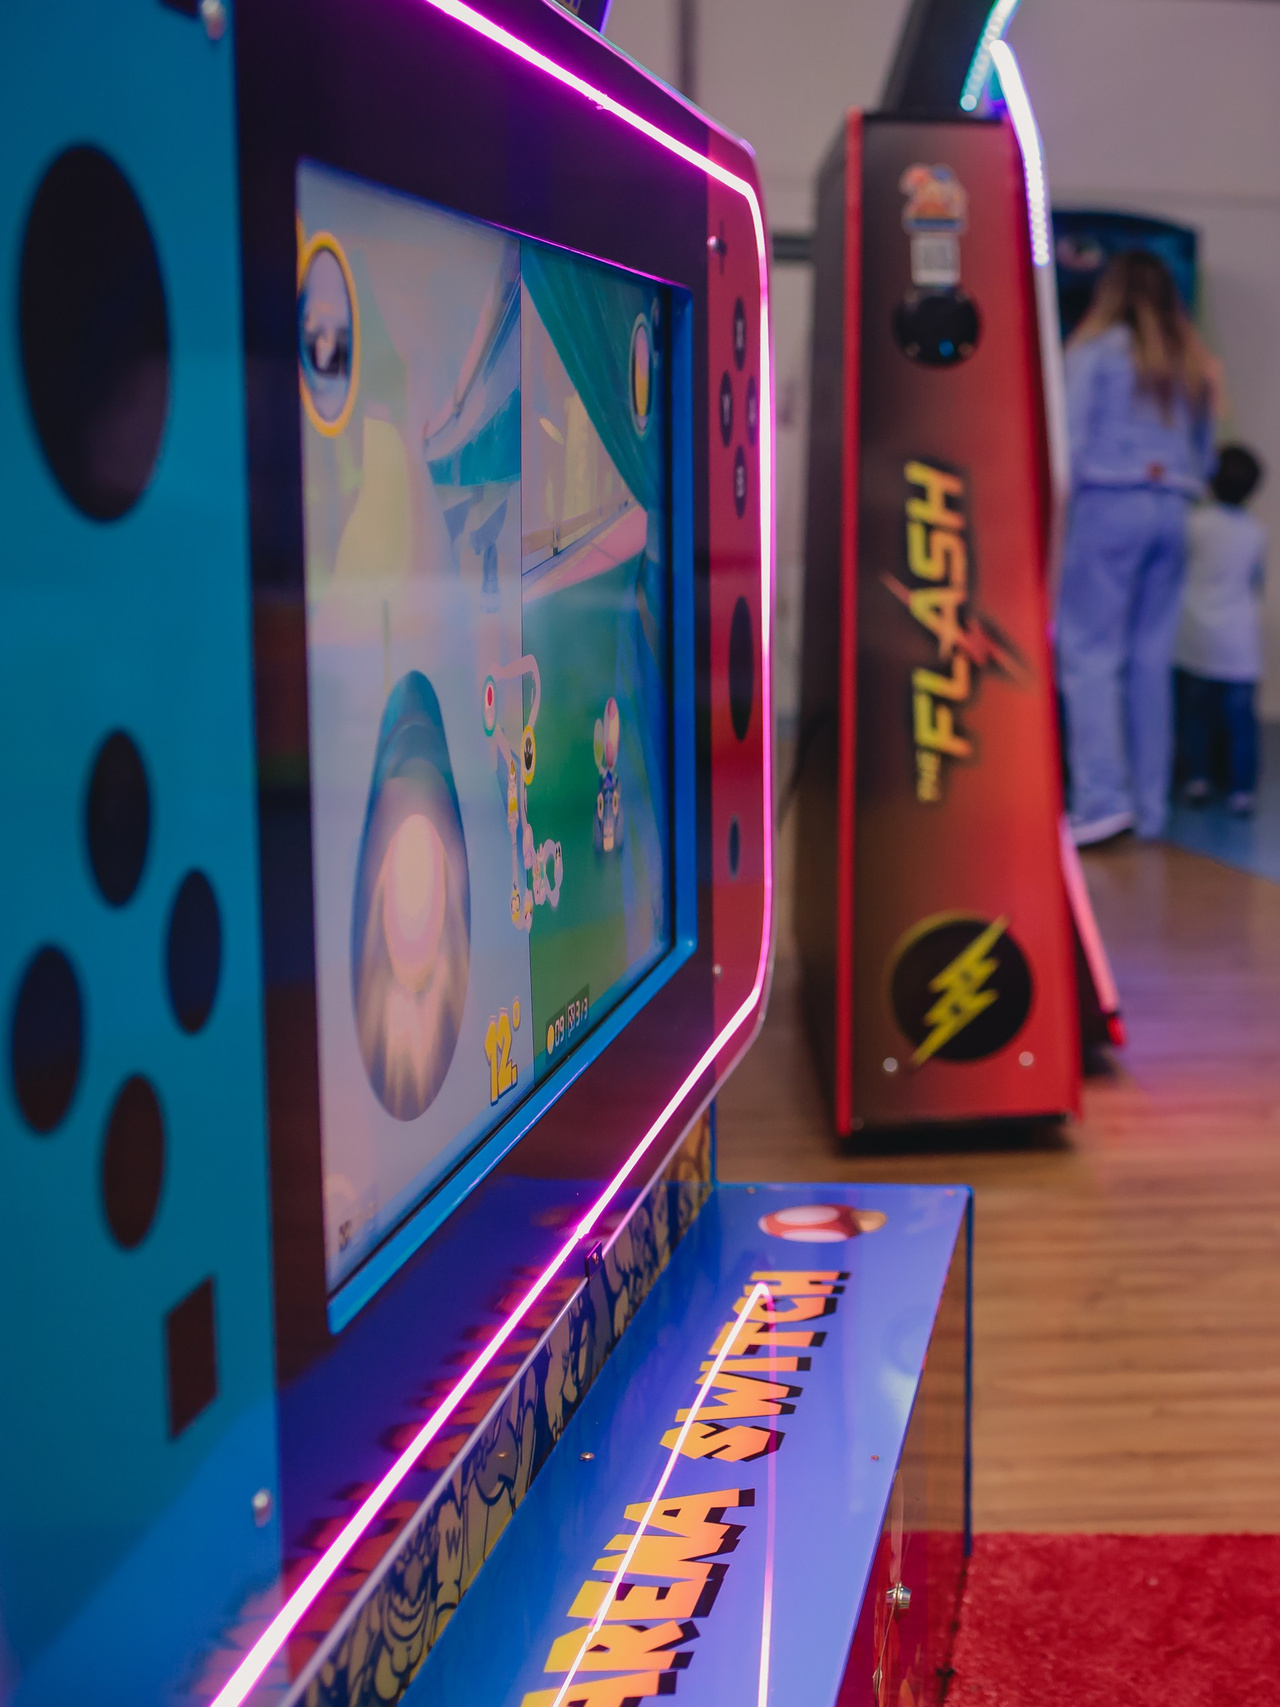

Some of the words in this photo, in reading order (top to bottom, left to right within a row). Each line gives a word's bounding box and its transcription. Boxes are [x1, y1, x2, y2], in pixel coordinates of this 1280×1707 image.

[904, 460, 972, 758] FLASH
[521, 1488, 755, 1707] ARENA
[659, 1270, 850, 1462] SWITCH
